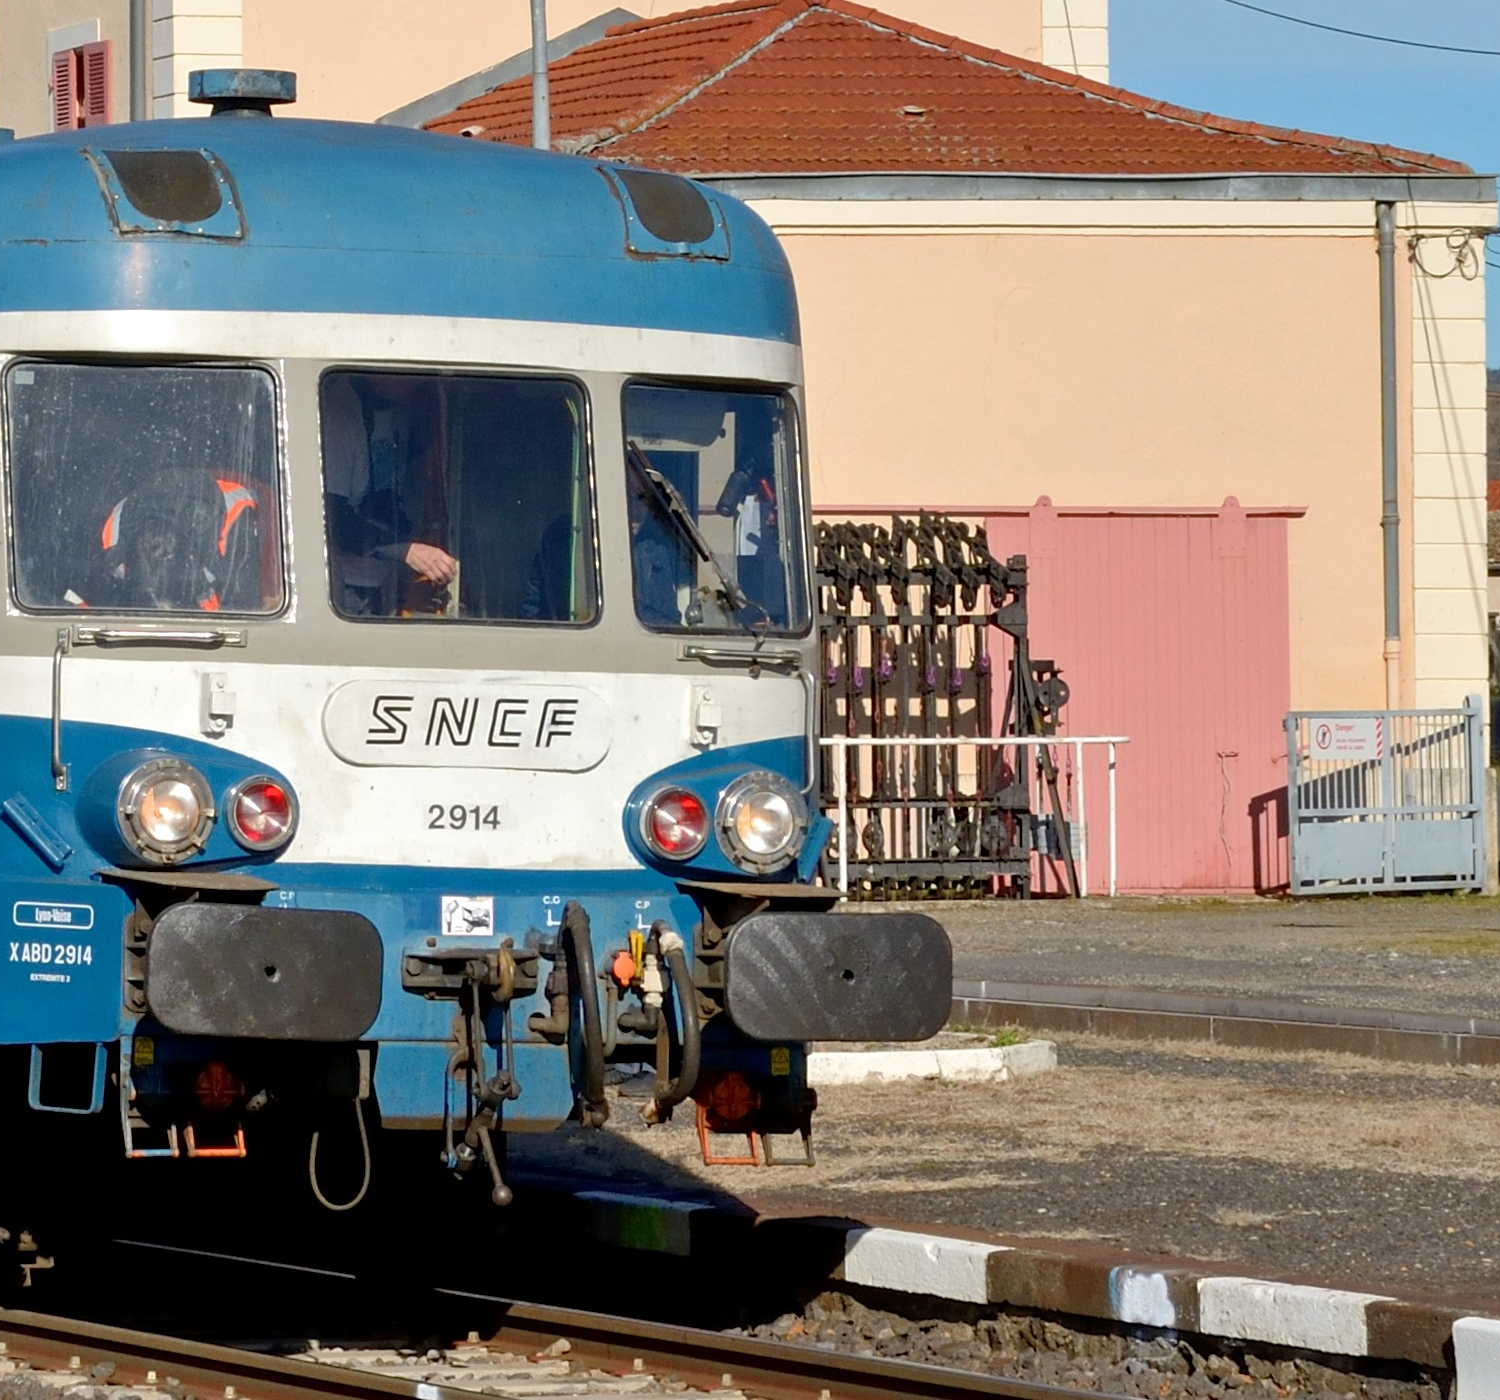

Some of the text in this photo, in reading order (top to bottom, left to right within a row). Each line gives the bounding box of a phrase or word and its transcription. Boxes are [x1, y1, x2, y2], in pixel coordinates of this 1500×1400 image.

[366, 695, 579, 748] SNCF
[428, 804, 501, 830] 2914
[54, 944, 93, 965] 2914
